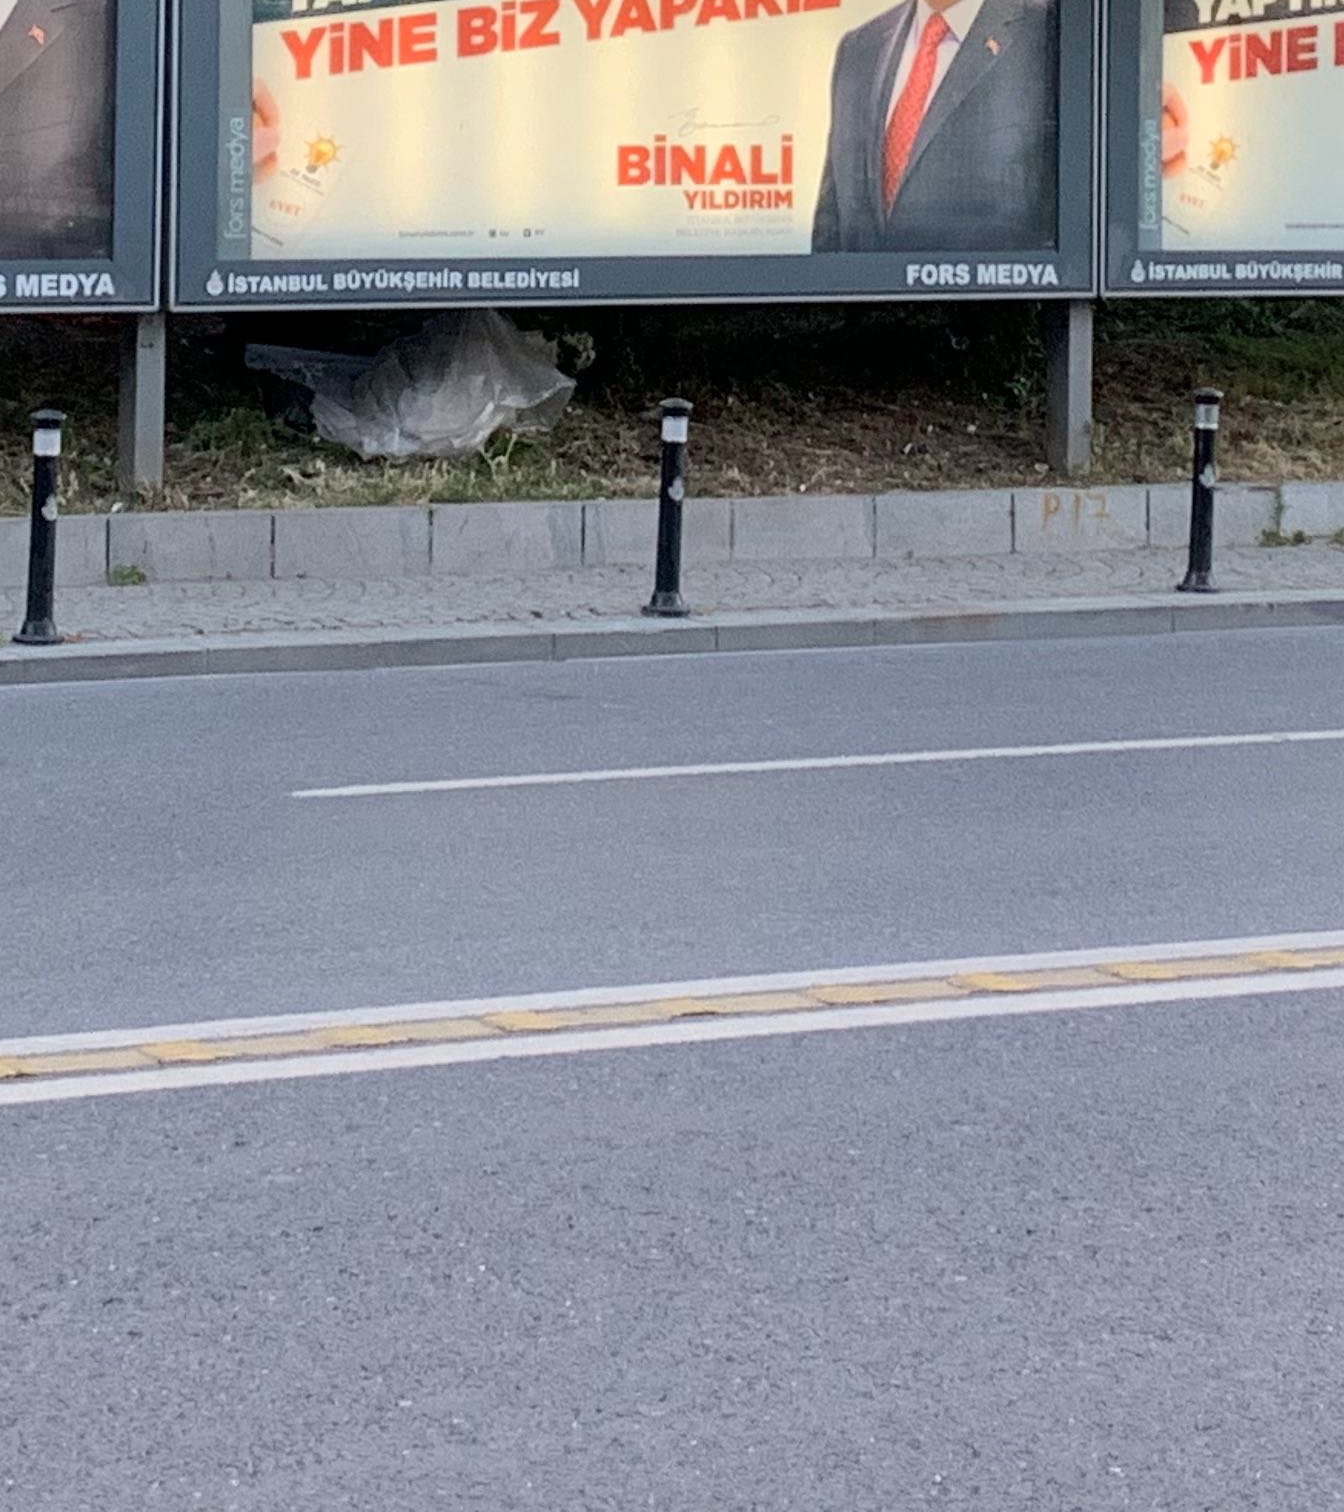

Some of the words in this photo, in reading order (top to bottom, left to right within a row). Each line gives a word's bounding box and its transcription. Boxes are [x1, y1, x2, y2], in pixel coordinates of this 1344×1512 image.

[280, 13, 437, 80] YİNE
[1188, 26, 1318, 84] YİNE
[617, 134, 793, 186] BİNALİ
[683, 189, 793, 210] YILDIRIM
[15, 272, 116, 297] MEDYA
[228, 272, 329, 294] İSTANBUL
[333, 268, 463, 292] BÜYÜKŞEHİR
[468, 267, 580, 288] BELEDİYESİ
[906, 264, 970, 286] FORS
[976, 264, 1059, 286] MEDYA
[1148, 261, 1232, 281] İSTANBUL
[1235, 260, 1343, 283] BÜYÜKŞEHİR
